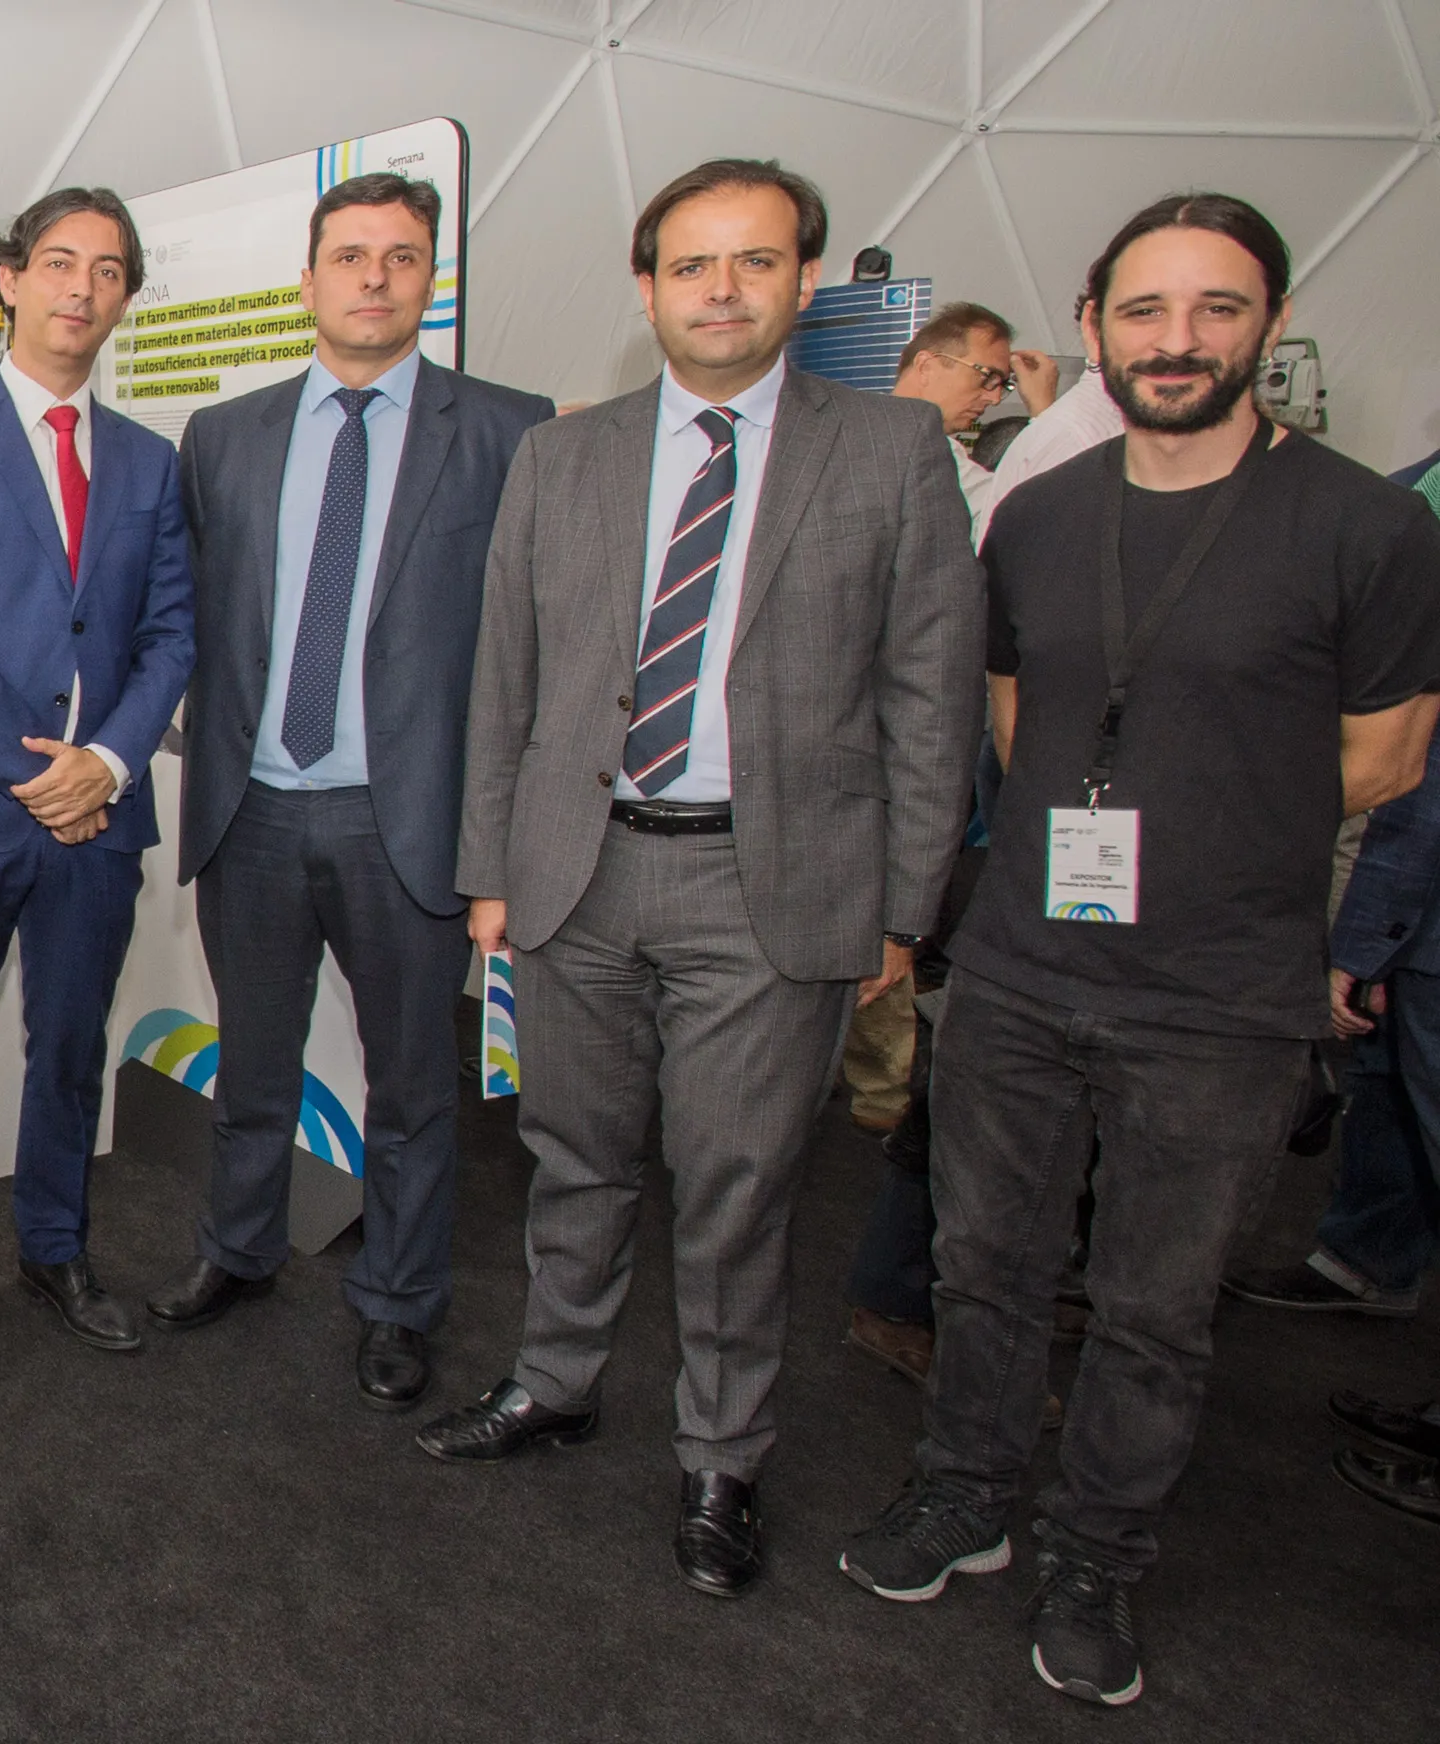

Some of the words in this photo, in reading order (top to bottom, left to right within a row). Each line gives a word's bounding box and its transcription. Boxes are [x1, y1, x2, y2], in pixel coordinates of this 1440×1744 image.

[387, 151, 425, 168] Semana
[147, 310, 167, 324] faro
[168, 304, 216, 321] marítimo
[218, 297, 235, 313] del
[238, 290, 280, 310] mundo
[181, 333, 195, 344] en
[196, 322, 252, 343] materiales
[132, 353, 207, 375] autosuficiencia
[209, 346, 267, 368] energética
[116, 385, 128, 399] de
[166, 377, 220, 395] renovables
